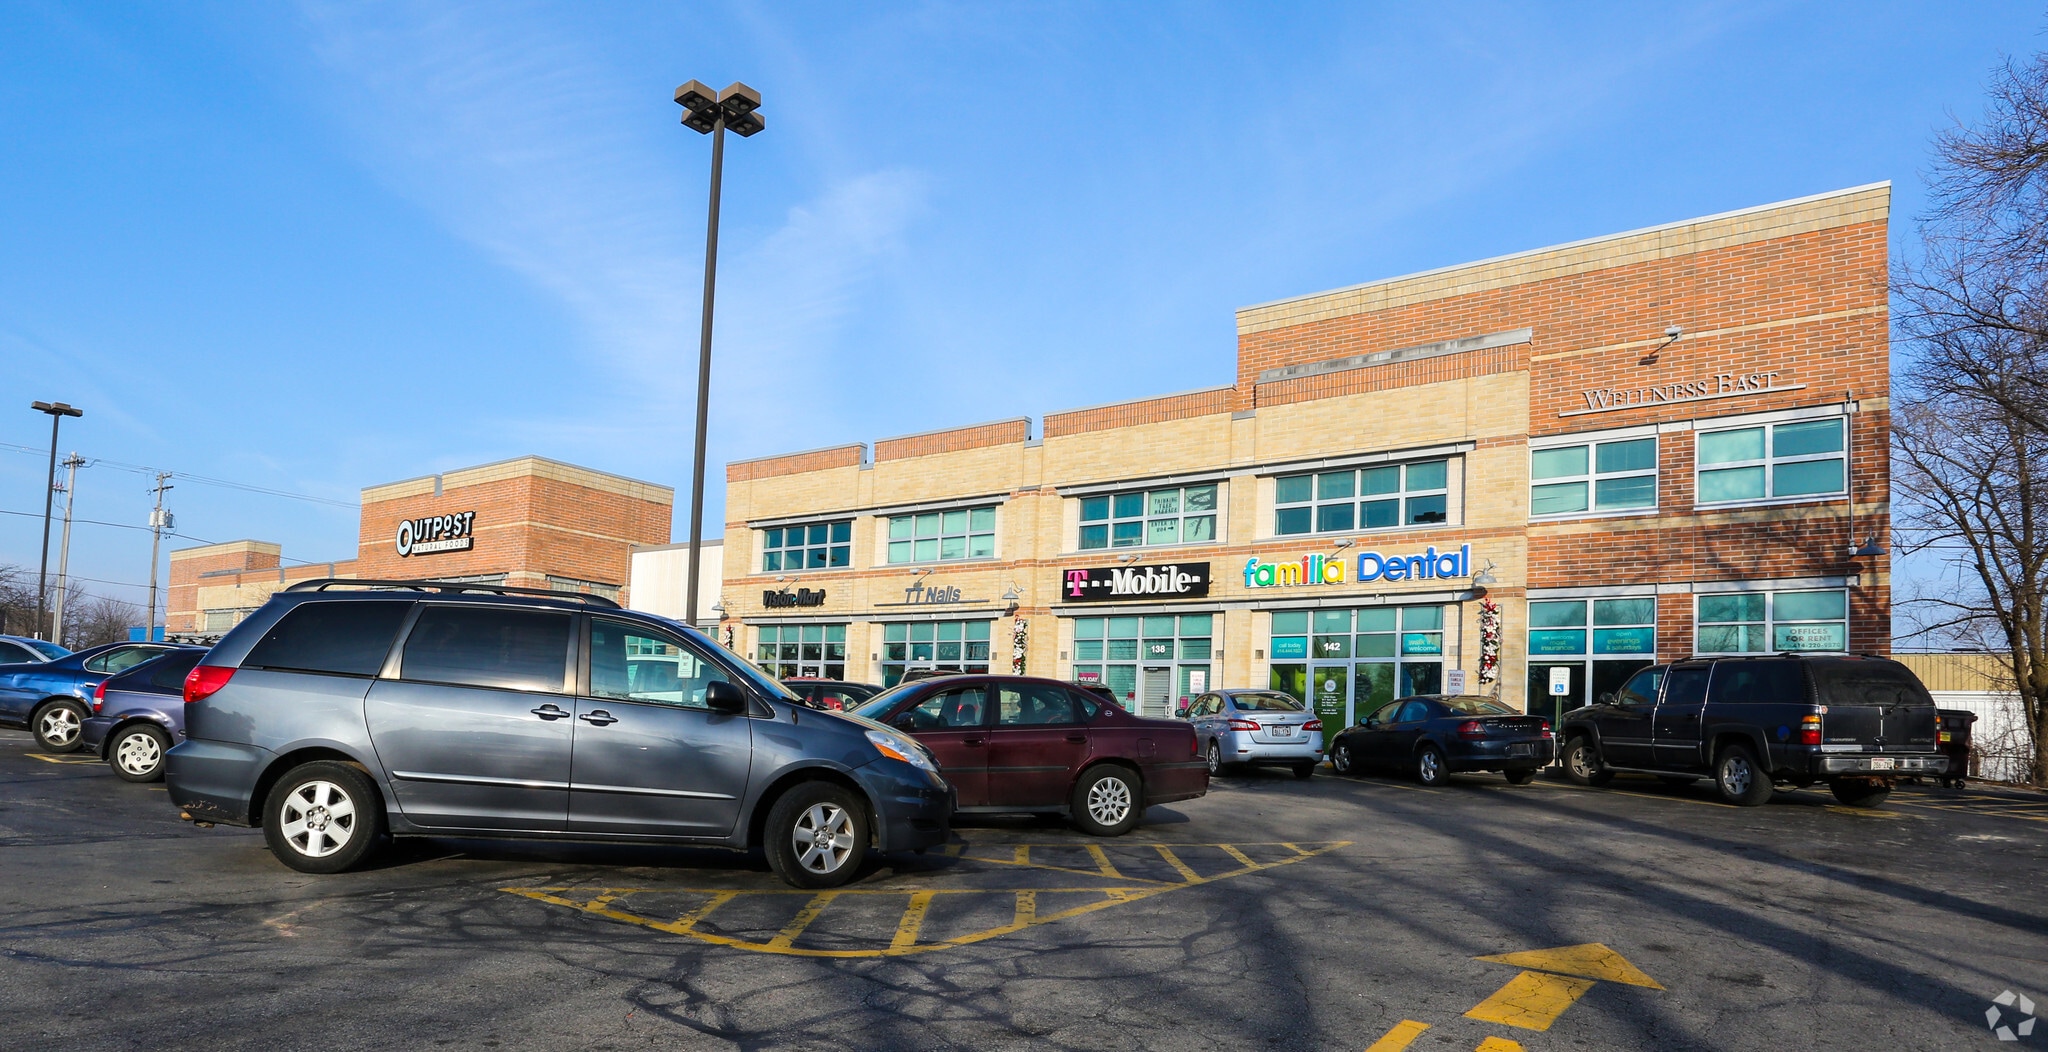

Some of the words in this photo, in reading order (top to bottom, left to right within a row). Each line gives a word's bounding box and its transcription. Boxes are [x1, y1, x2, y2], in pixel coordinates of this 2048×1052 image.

[1583, 381, 1709, 410] WELLNESS
[1714, 371, 1779, 394] EAST
[396, 511, 475, 556] OUTPOST
[412, 542, 442, 552] NATURAL
[445, 538, 469, 548] FOODS
[1244, 553, 1347, 588] familia
[1358, 543, 1472, 582] Dental
[905, 587, 925, 604] TT
[926, 586, 962, 603] Nails
[1151, 645, 1166, 653] 138
[1323, 642, 1341, 651] 142
